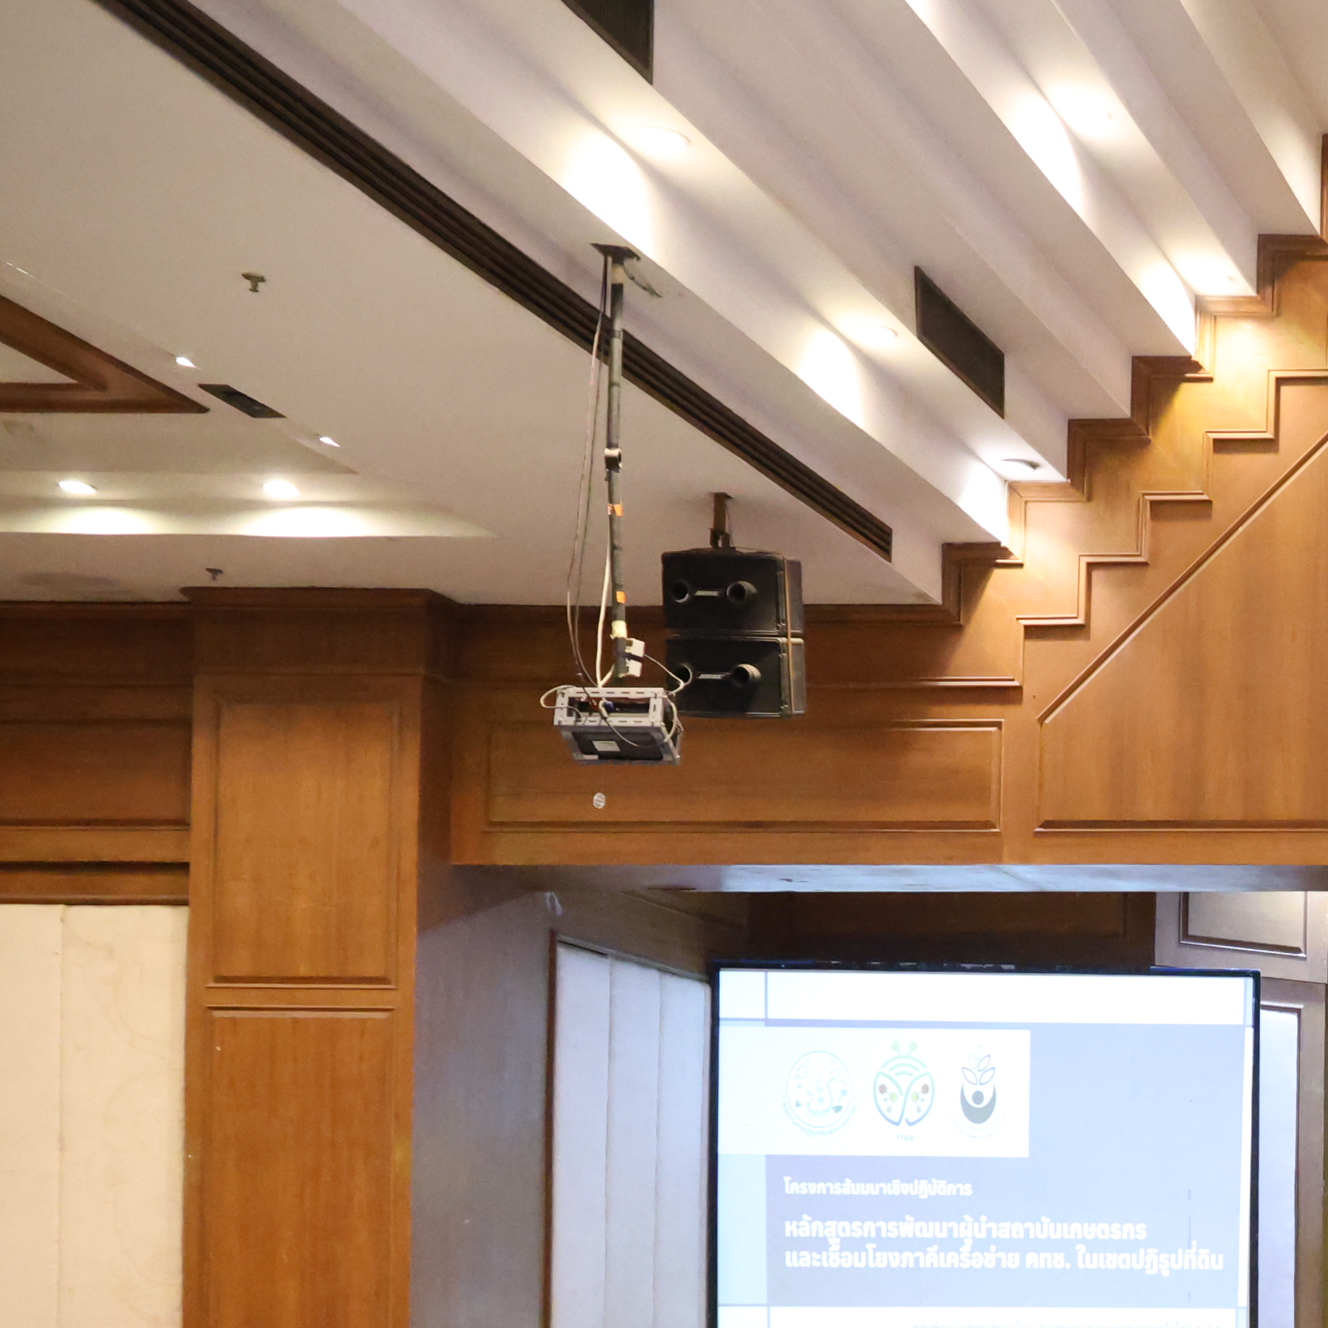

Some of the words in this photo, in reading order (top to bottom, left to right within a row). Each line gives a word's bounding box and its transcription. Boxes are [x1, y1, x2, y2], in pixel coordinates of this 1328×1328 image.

[784, 1176, 973, 1199] โครงการสัมมนาเชิงปฏิบัติการ
[785, 1214, 1147, 1246] หลักสูตรการพัฒนาผู้นำสถาบันเกษตรกร
[785, 1241, 1020, 1269] และเชื่อมโยงภาคีเครือข่าย
[1025, 1251, 1071, 1270] คทช.
[1075, 1241, 1224, 1277] ในเขตปฏิรูปที่ดิน
